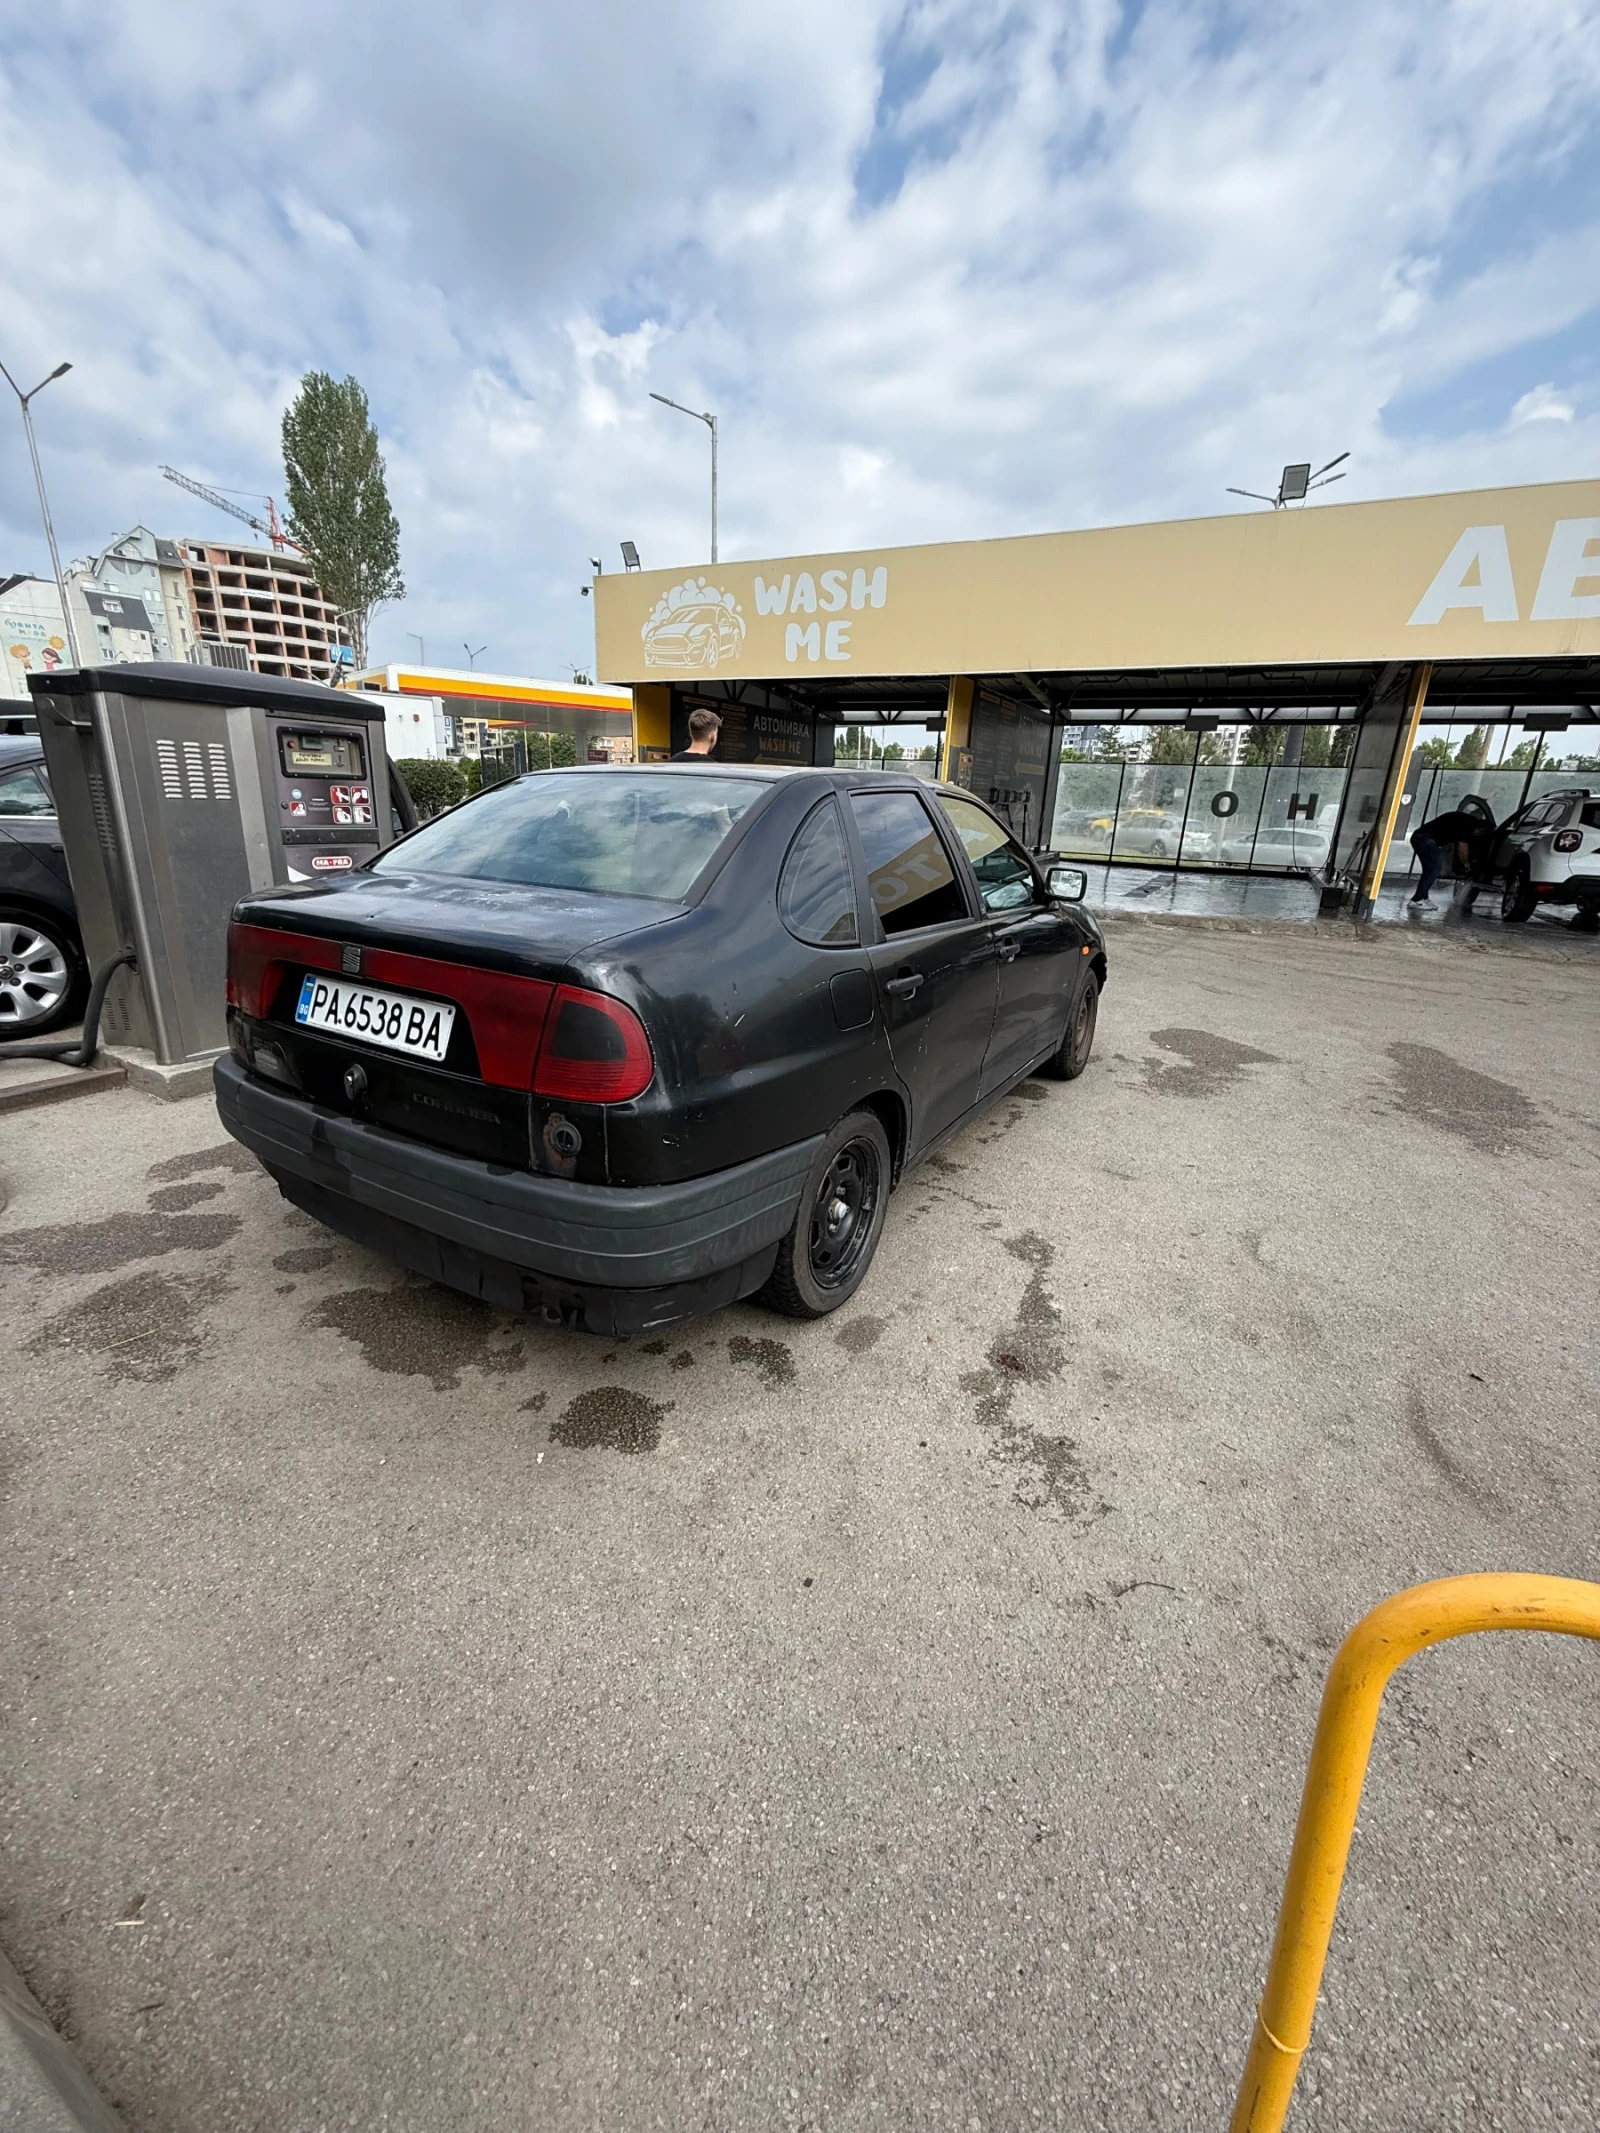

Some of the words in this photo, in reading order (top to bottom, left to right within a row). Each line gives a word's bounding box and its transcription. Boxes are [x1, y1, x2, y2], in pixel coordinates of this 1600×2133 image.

[754, 566, 888, 616] WASH
[785, 620, 852, 662] ME
[753, 715, 809, 738] АВТОМИВКА
[759, 736, 785, 752] WASH
[788, 741, 801, 754] ME
[299, 1003, 309, 1015] BG
